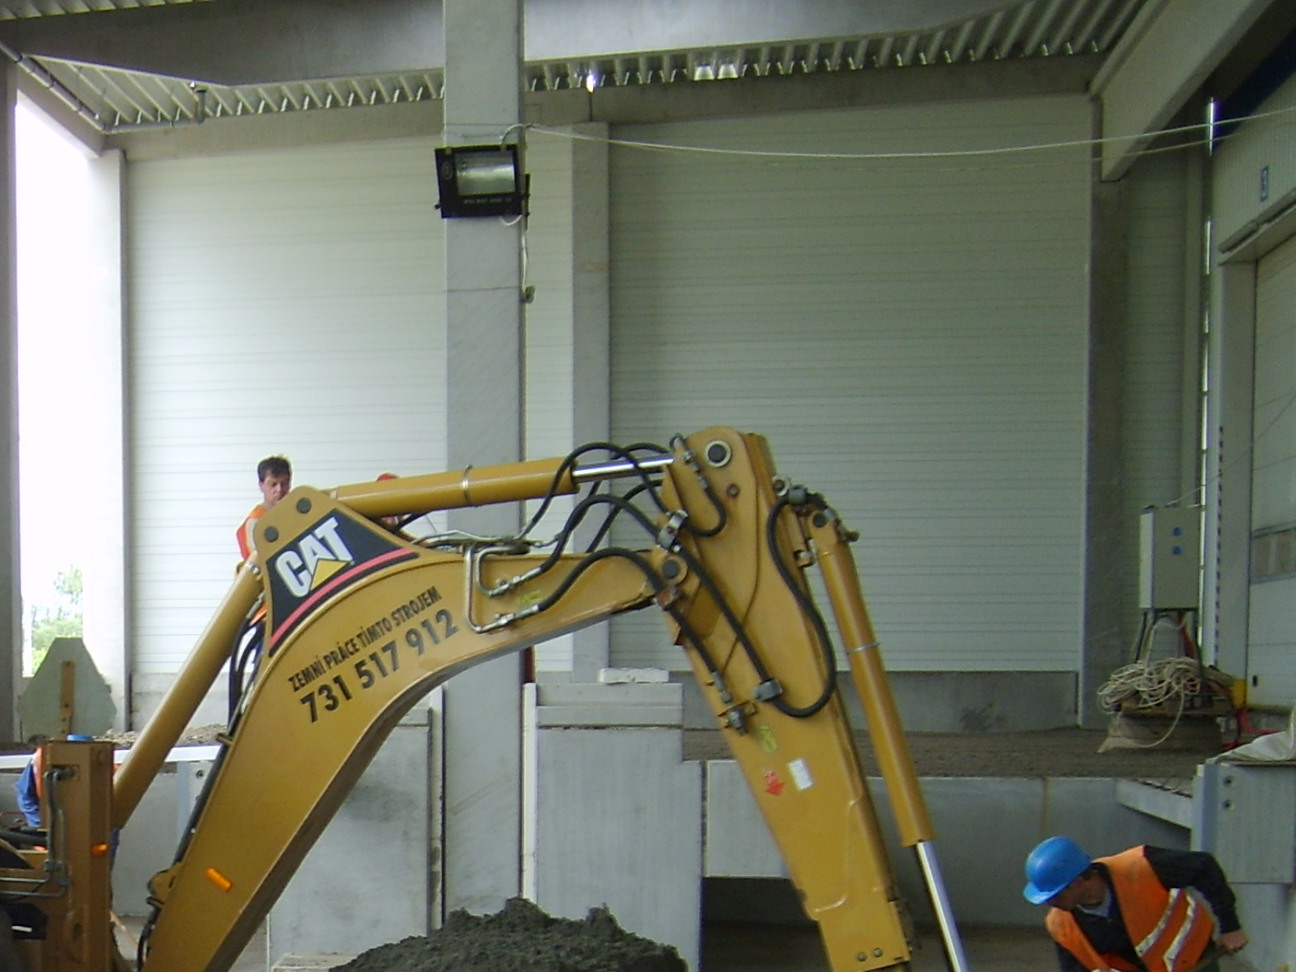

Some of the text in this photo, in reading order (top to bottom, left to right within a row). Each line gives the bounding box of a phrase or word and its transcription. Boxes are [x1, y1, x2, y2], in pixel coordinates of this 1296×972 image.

[275, 516, 354, 598] CAT
[288, 585, 443, 692] ZEMNÍ PRÁCE TÍMTO STROJEM
[300, 609, 460, 723] 731 517 912
